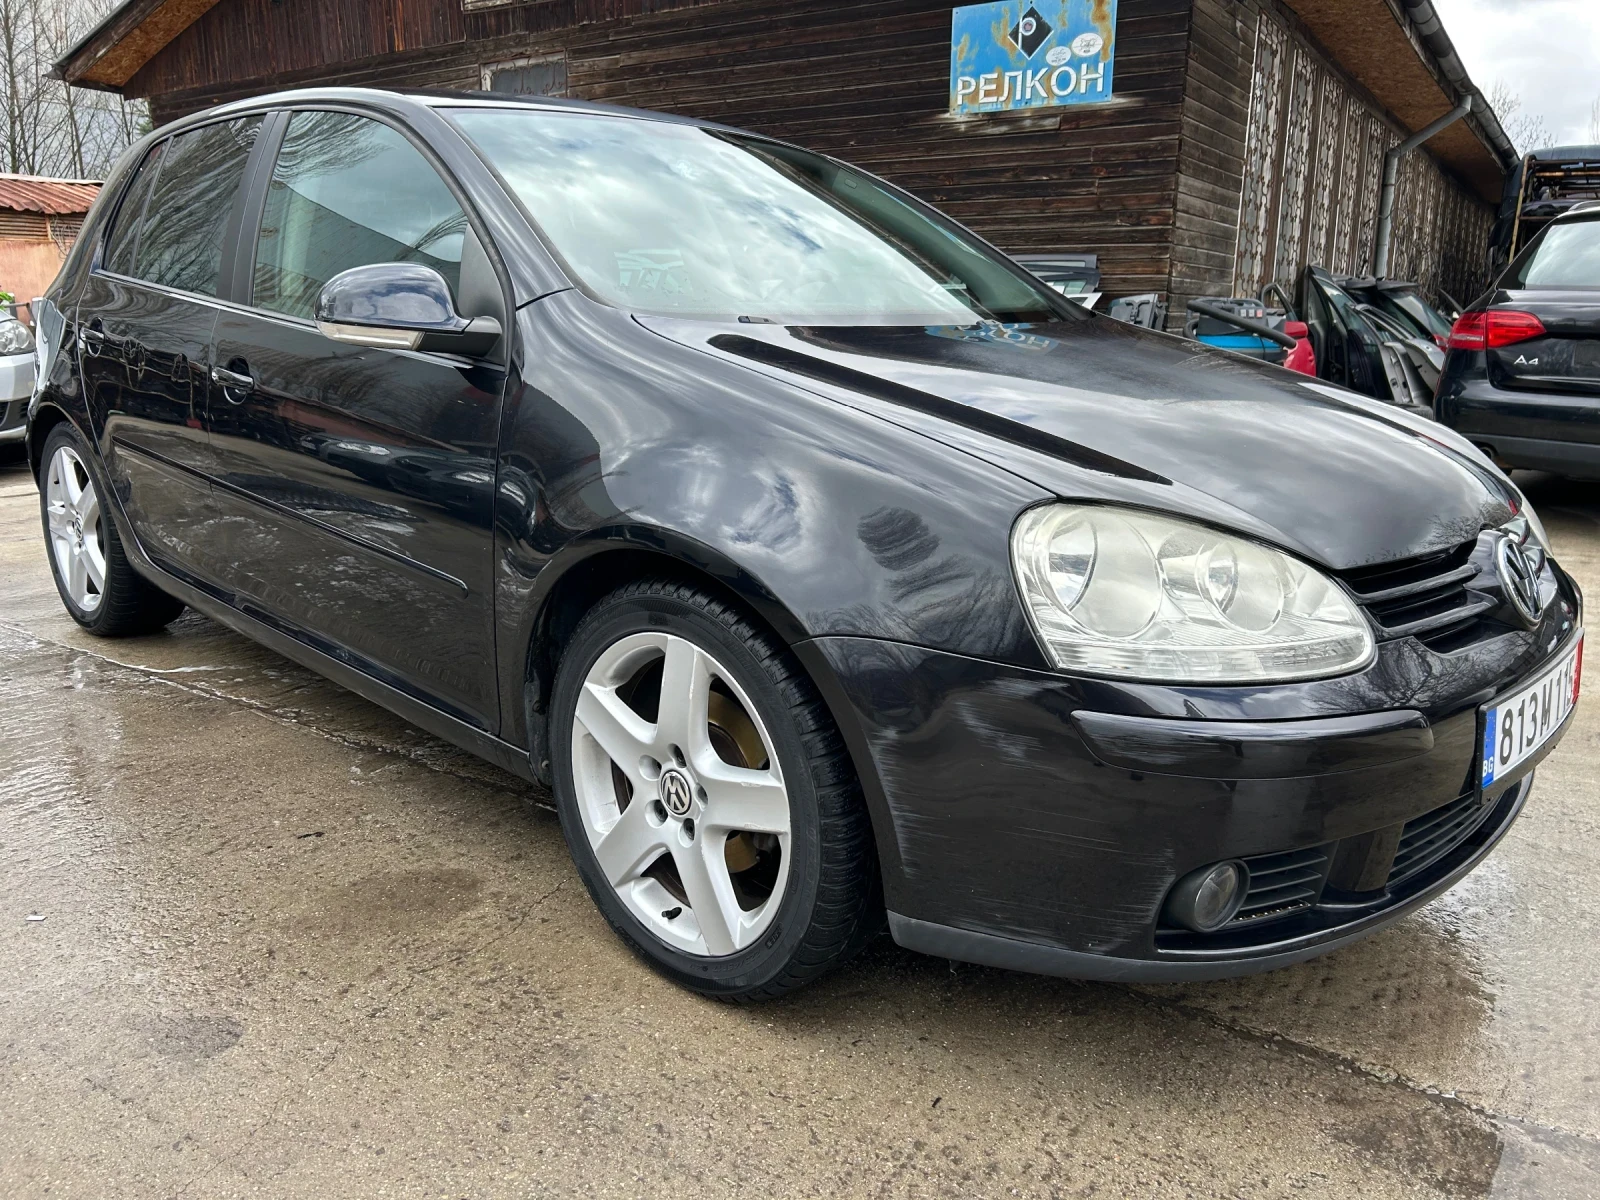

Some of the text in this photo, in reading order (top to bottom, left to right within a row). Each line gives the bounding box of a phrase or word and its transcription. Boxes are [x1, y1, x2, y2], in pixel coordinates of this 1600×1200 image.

[957, 62, 1105, 106] РЕЛКОН
[1513, 354, 1539, 365] A4
[1482, 756, 1494, 777] BG
